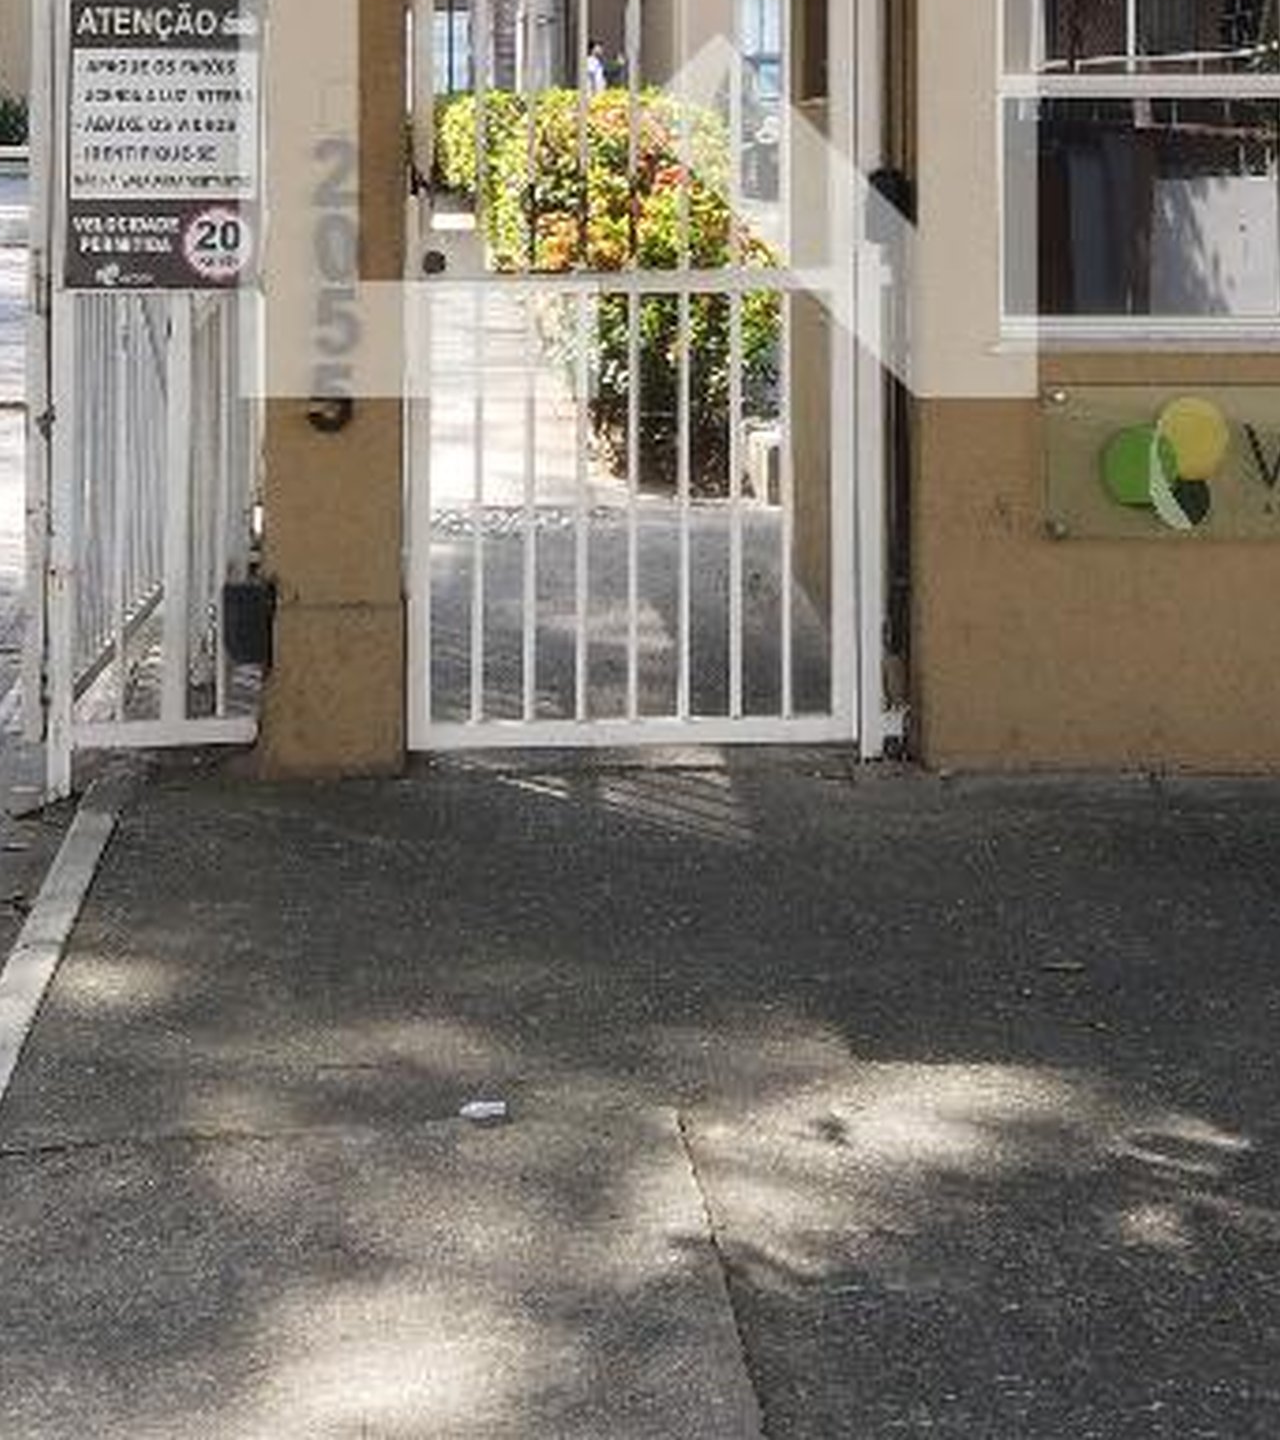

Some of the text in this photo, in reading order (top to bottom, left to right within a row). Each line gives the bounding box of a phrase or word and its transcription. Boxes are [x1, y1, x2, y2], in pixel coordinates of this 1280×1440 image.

[76, 2, 217, 42] ATENÇÃO
[196, 219, 241, 252] 20
[306, 138, 360, 432] 2055
